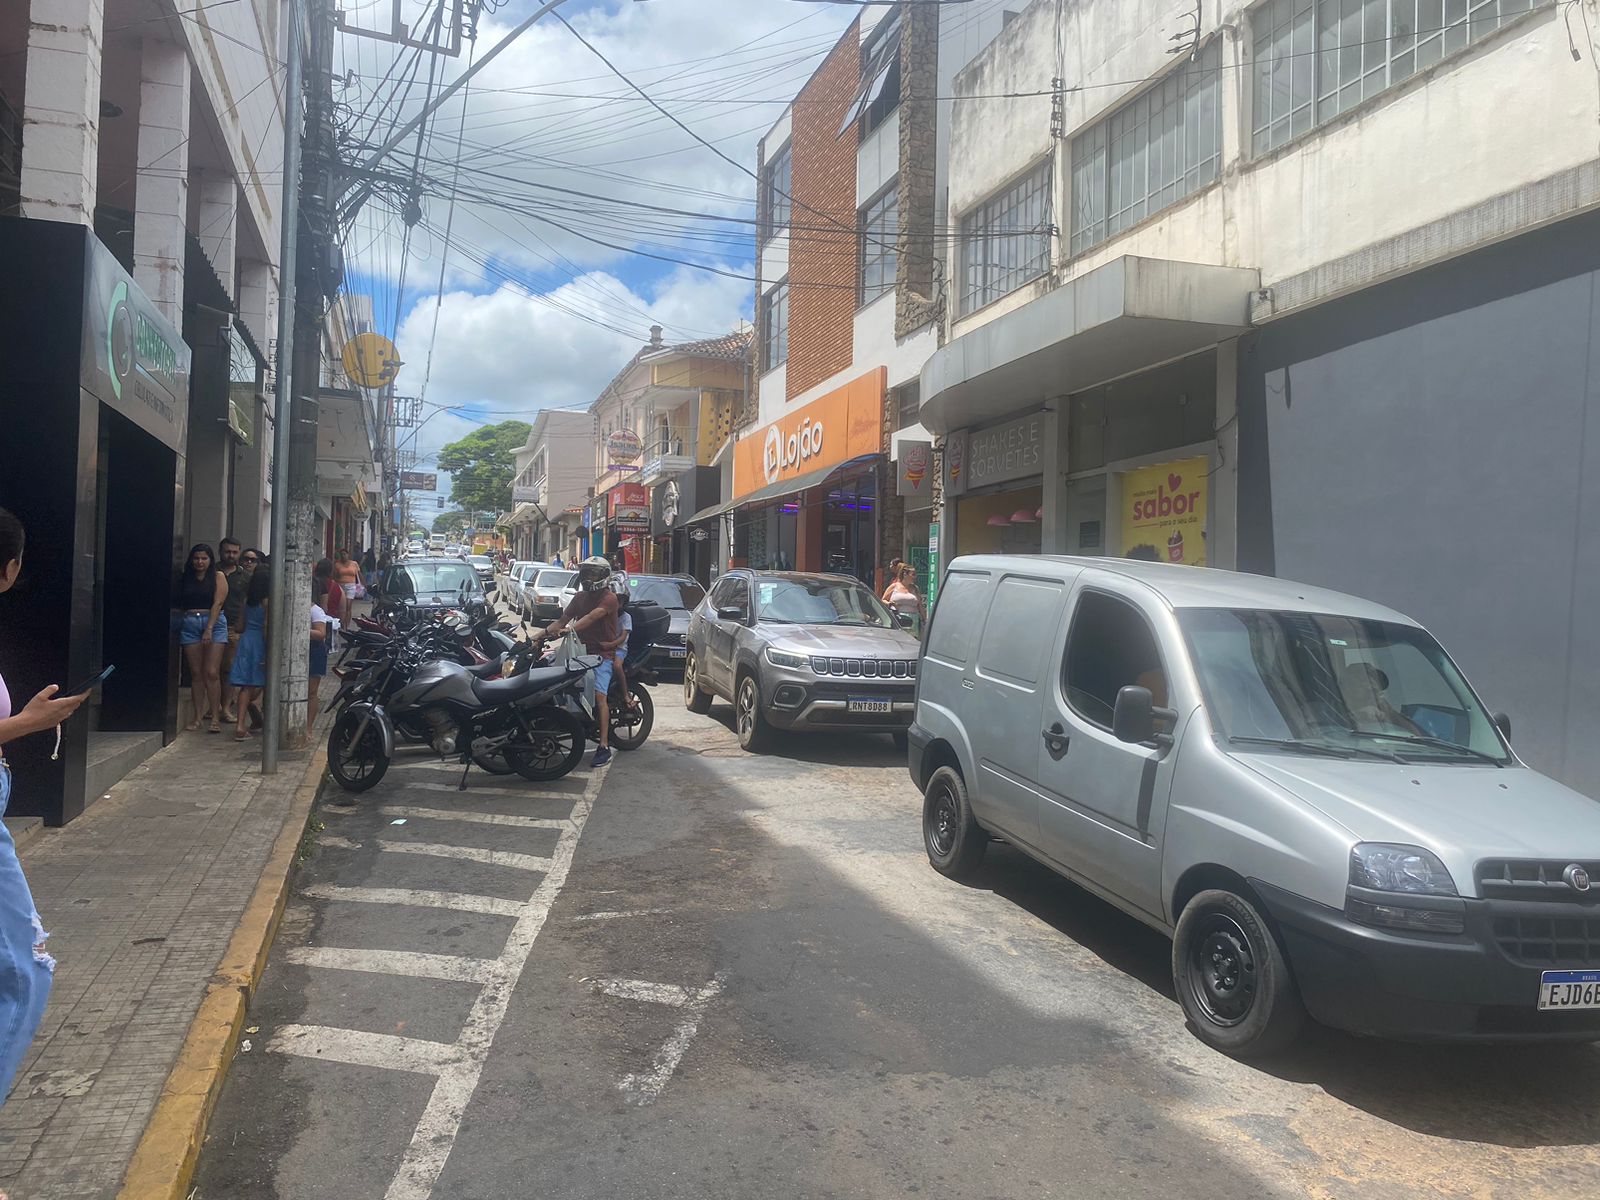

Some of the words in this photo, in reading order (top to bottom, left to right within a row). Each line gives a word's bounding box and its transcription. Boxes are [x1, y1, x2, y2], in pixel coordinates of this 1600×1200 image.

[781, 417, 823, 470] Lojão
[971, 426, 1024, 458] SHAKES
[1030, 421, 1039, 441] E
[970, 444, 1040, 479] SORVETES
[1133, 485, 1200, 521] sabor
